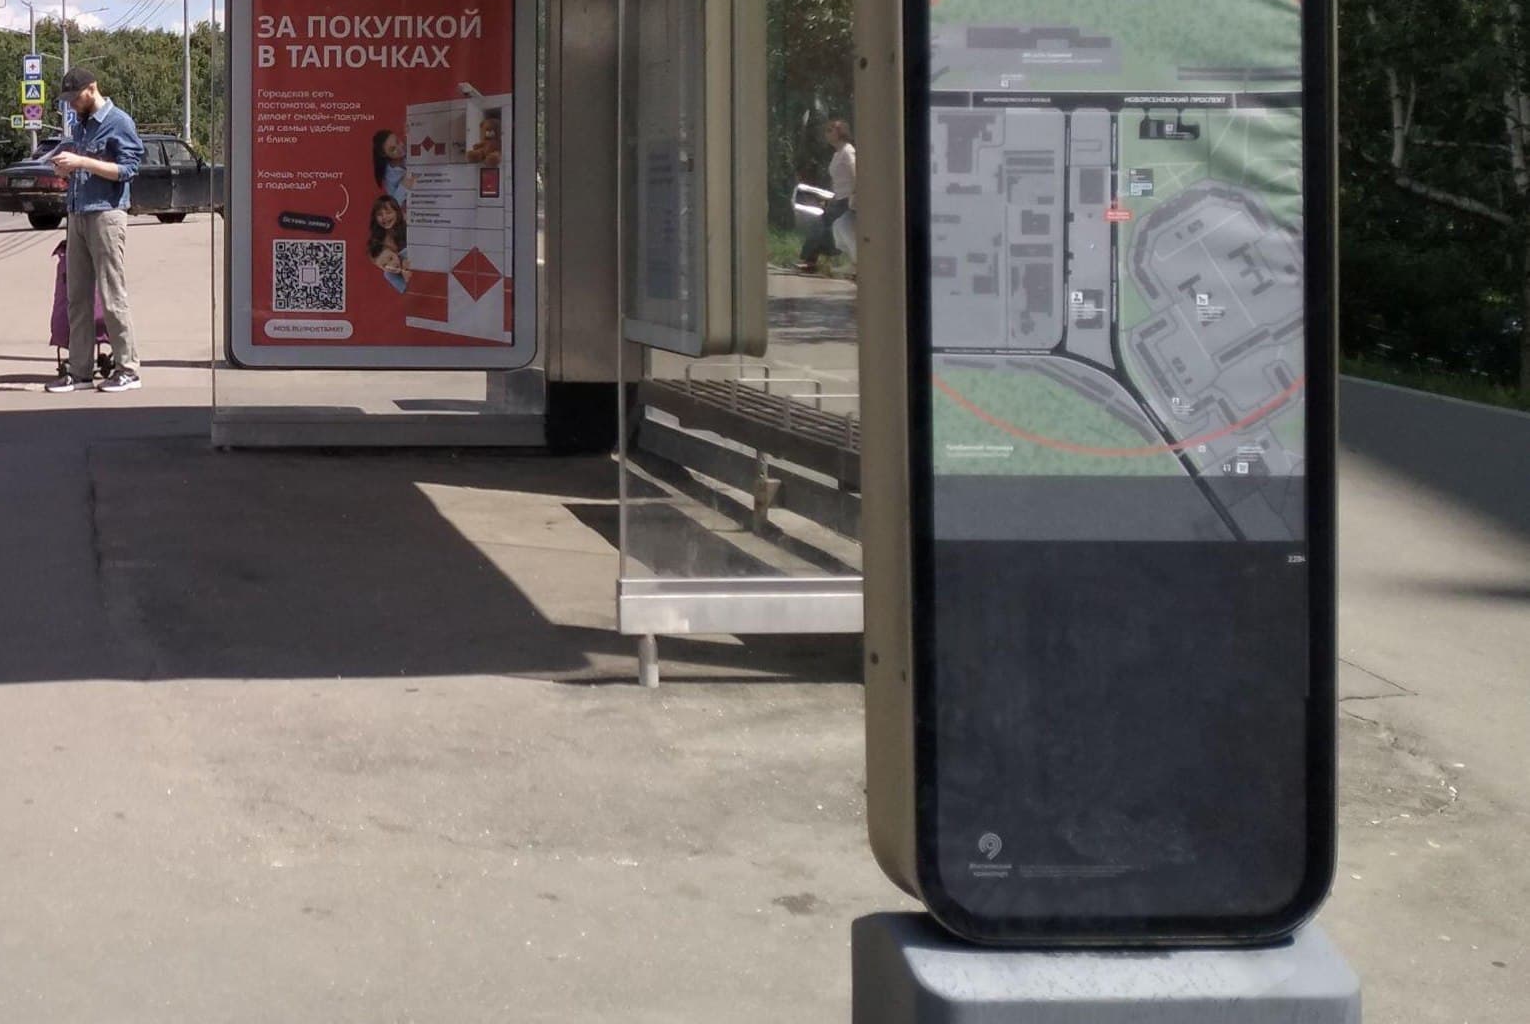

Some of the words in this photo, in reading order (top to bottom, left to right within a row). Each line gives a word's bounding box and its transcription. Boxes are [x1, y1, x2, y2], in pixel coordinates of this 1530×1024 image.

[257, 15, 297, 39] ЗА
[307, 9, 482, 39] ПОКУПКОЙ
[258, 46, 276, 68] В
[286, 45, 451, 69] ТАПОЧКАХ
[257, 88, 310, 98] Городская
[311, 90, 335, 98] сеть
[320, 102, 361, 110] которая
[257, 125, 274, 133] для
[266, 134, 298, 144] ближе
[297, 171, 343, 179] постамат
